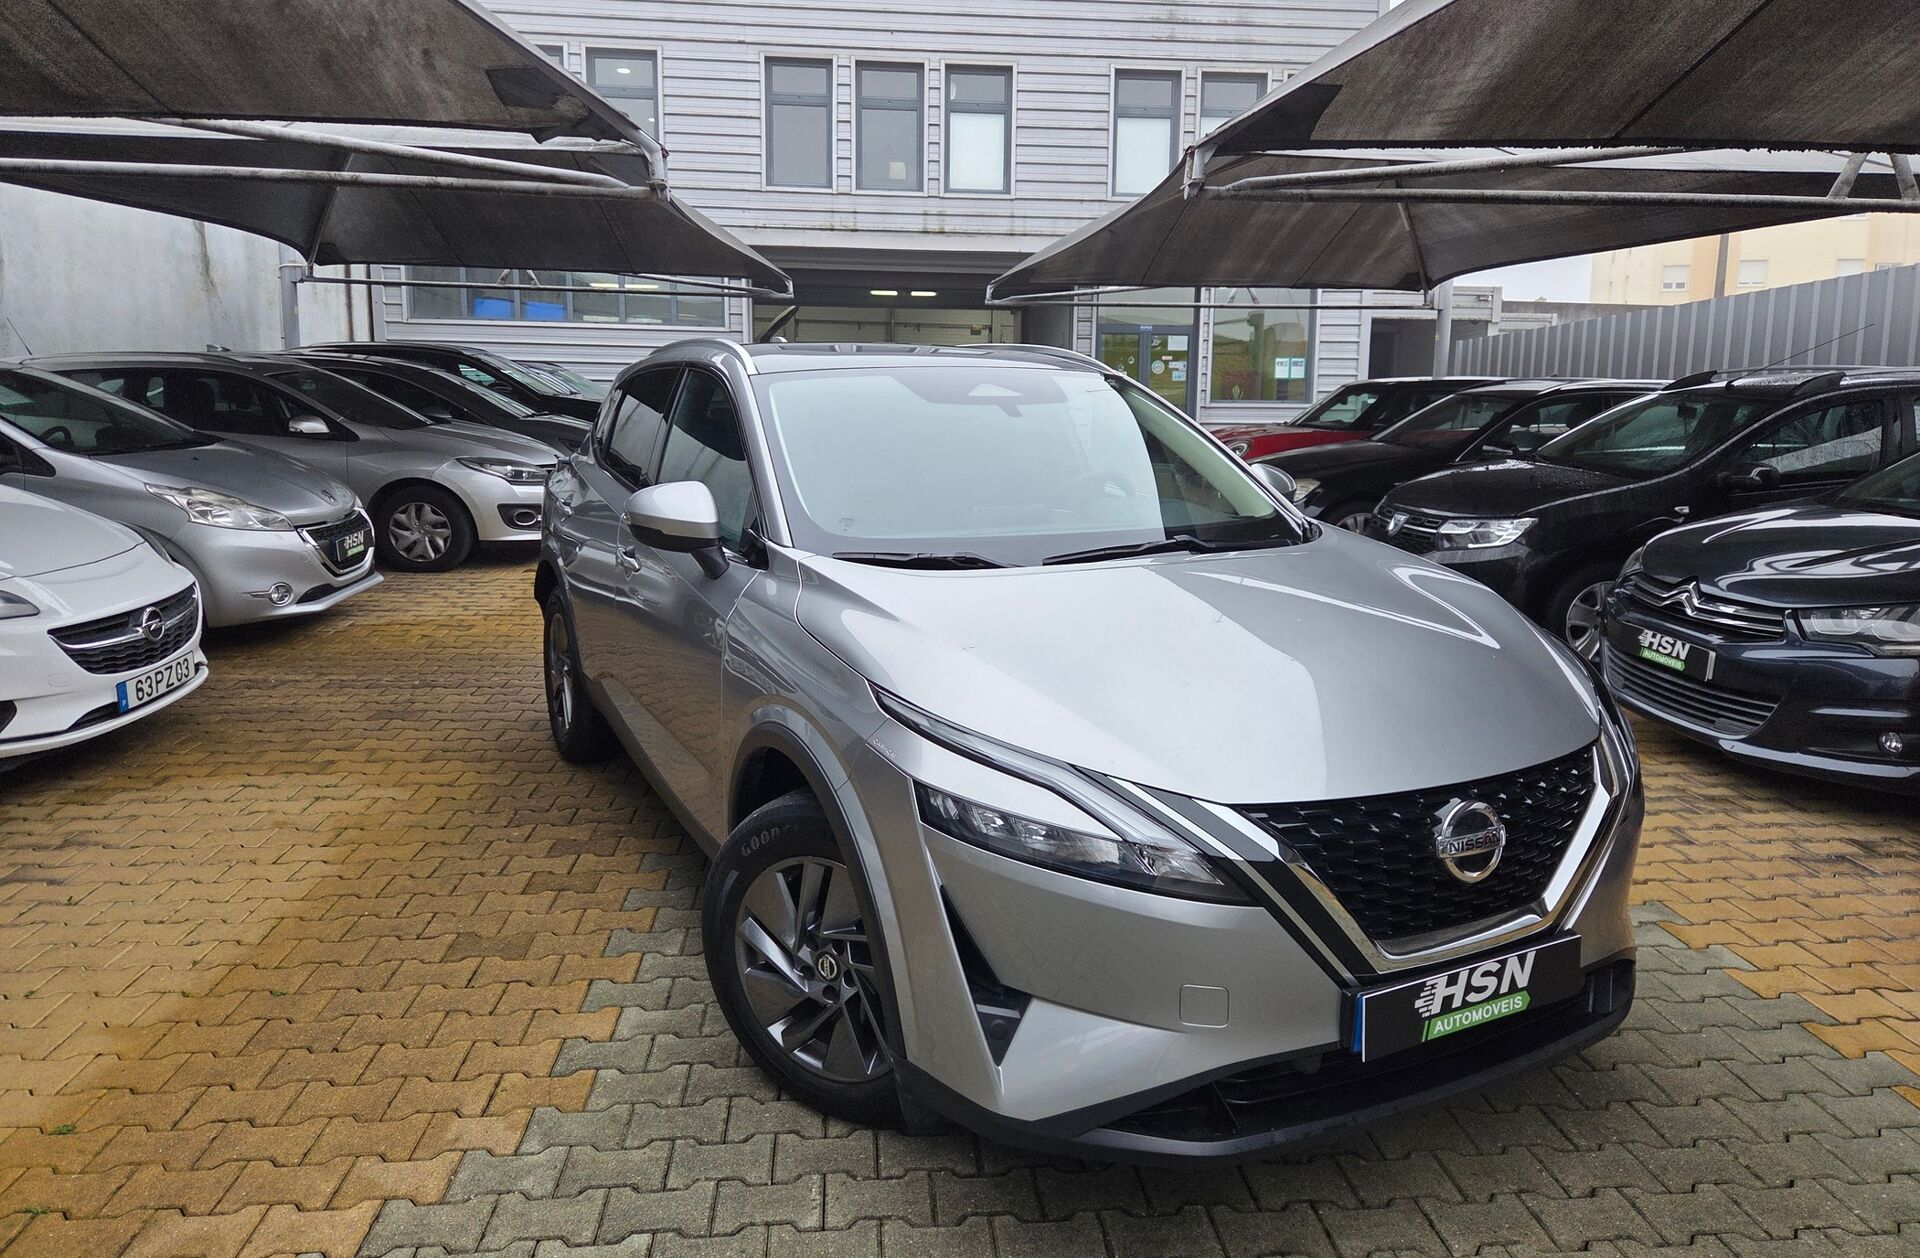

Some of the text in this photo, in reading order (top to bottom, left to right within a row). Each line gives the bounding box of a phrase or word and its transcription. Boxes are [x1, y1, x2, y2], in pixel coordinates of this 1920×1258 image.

[345, 530, 364, 549] HSN
[1640, 629, 1691, 660] HSN
[135, 658, 190, 702] 63PZ03
[1449, 831, 1500, 853] NISSAN
[1425, 951, 1537, 1017] HSN
